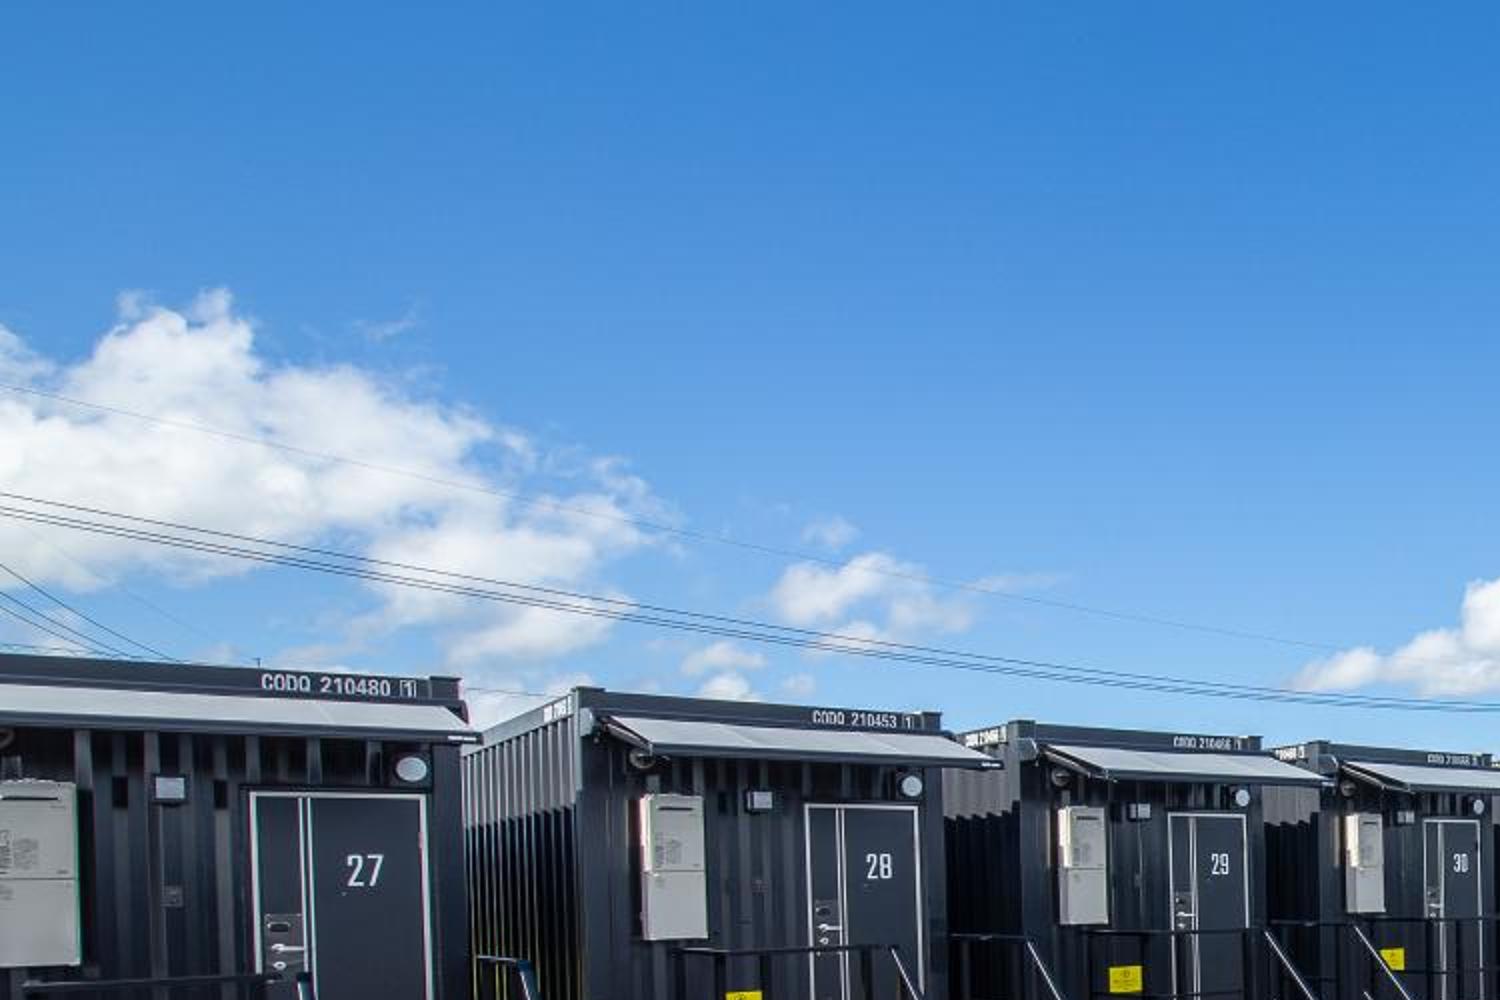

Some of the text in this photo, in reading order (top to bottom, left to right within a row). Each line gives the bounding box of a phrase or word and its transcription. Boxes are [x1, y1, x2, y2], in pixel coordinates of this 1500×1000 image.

[320, 676, 391, 696] 210480
[347, 854, 384, 887] 27
[866, 853, 892, 879] 28
[1211, 853, 1229, 875] 29
[1453, 853, 1469, 873] 30
